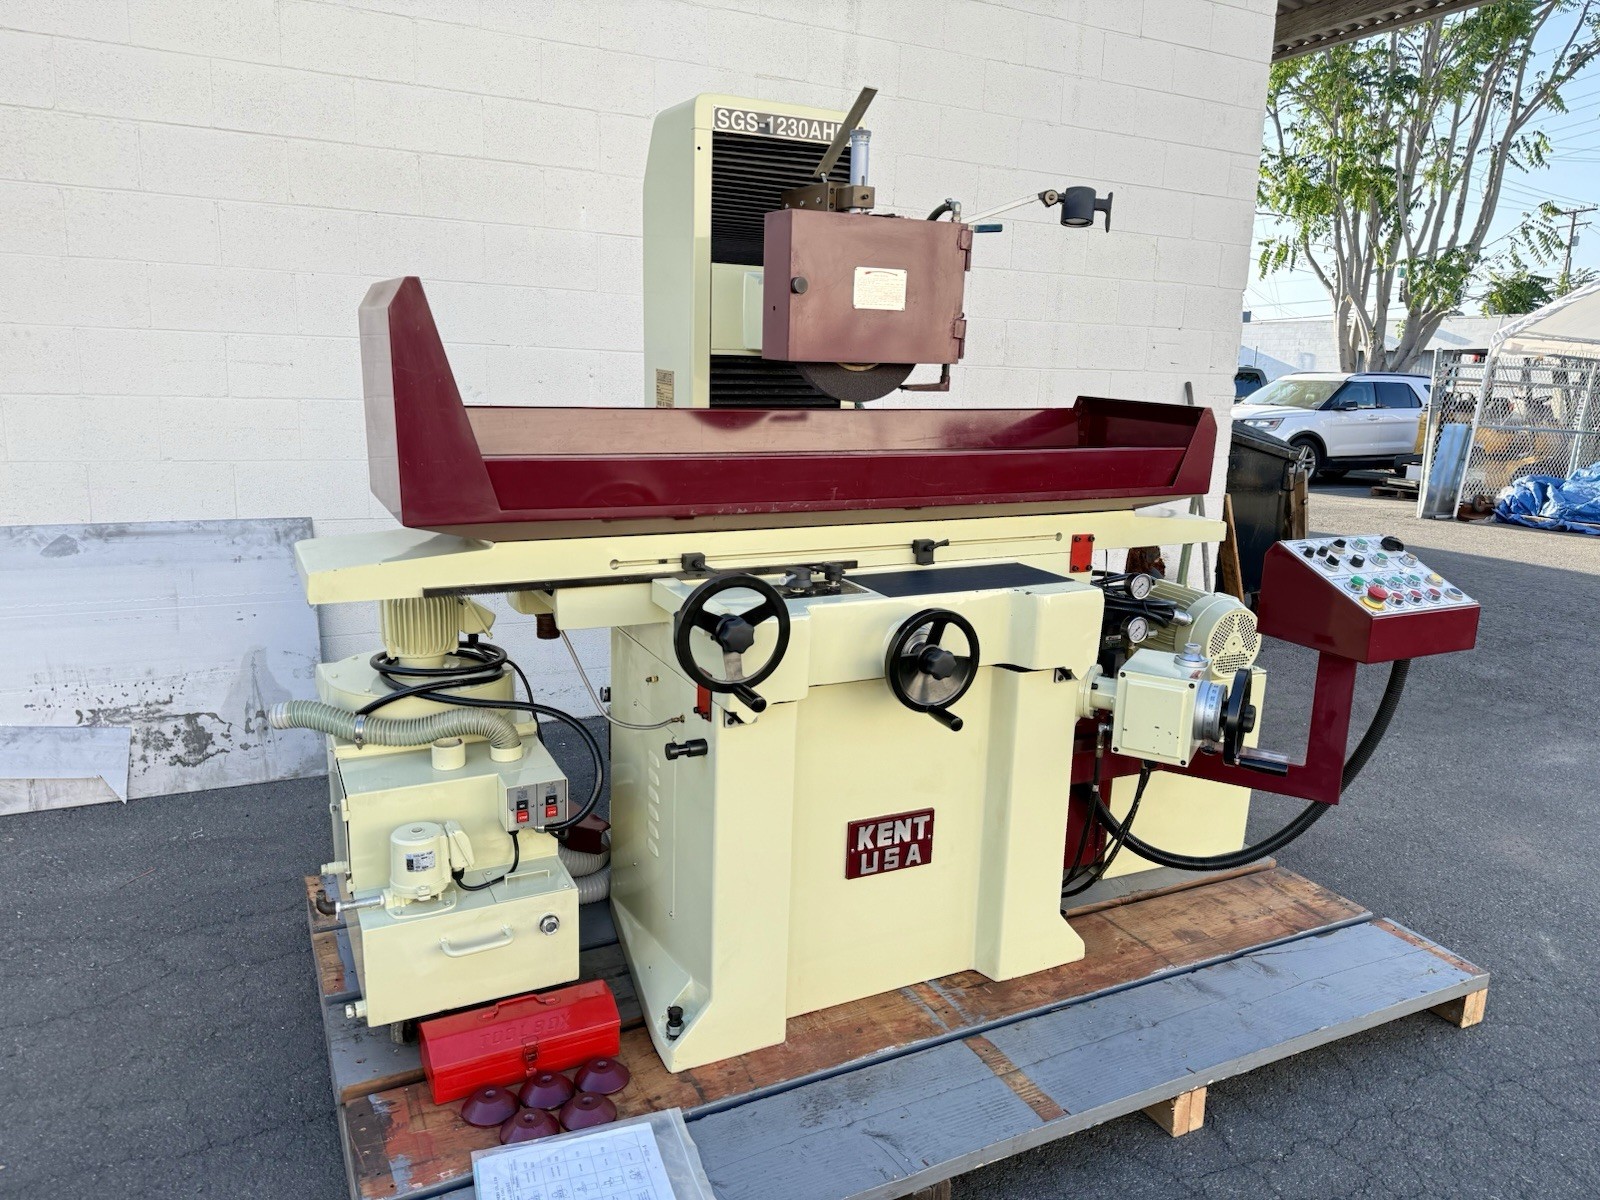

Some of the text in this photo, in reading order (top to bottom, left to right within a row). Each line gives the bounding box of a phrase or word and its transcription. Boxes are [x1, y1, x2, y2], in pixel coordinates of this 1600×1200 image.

[857, 815, 931, 851] KENT
[860, 843, 922, 875] USA
[535, 1012, 570, 1034] BOX
